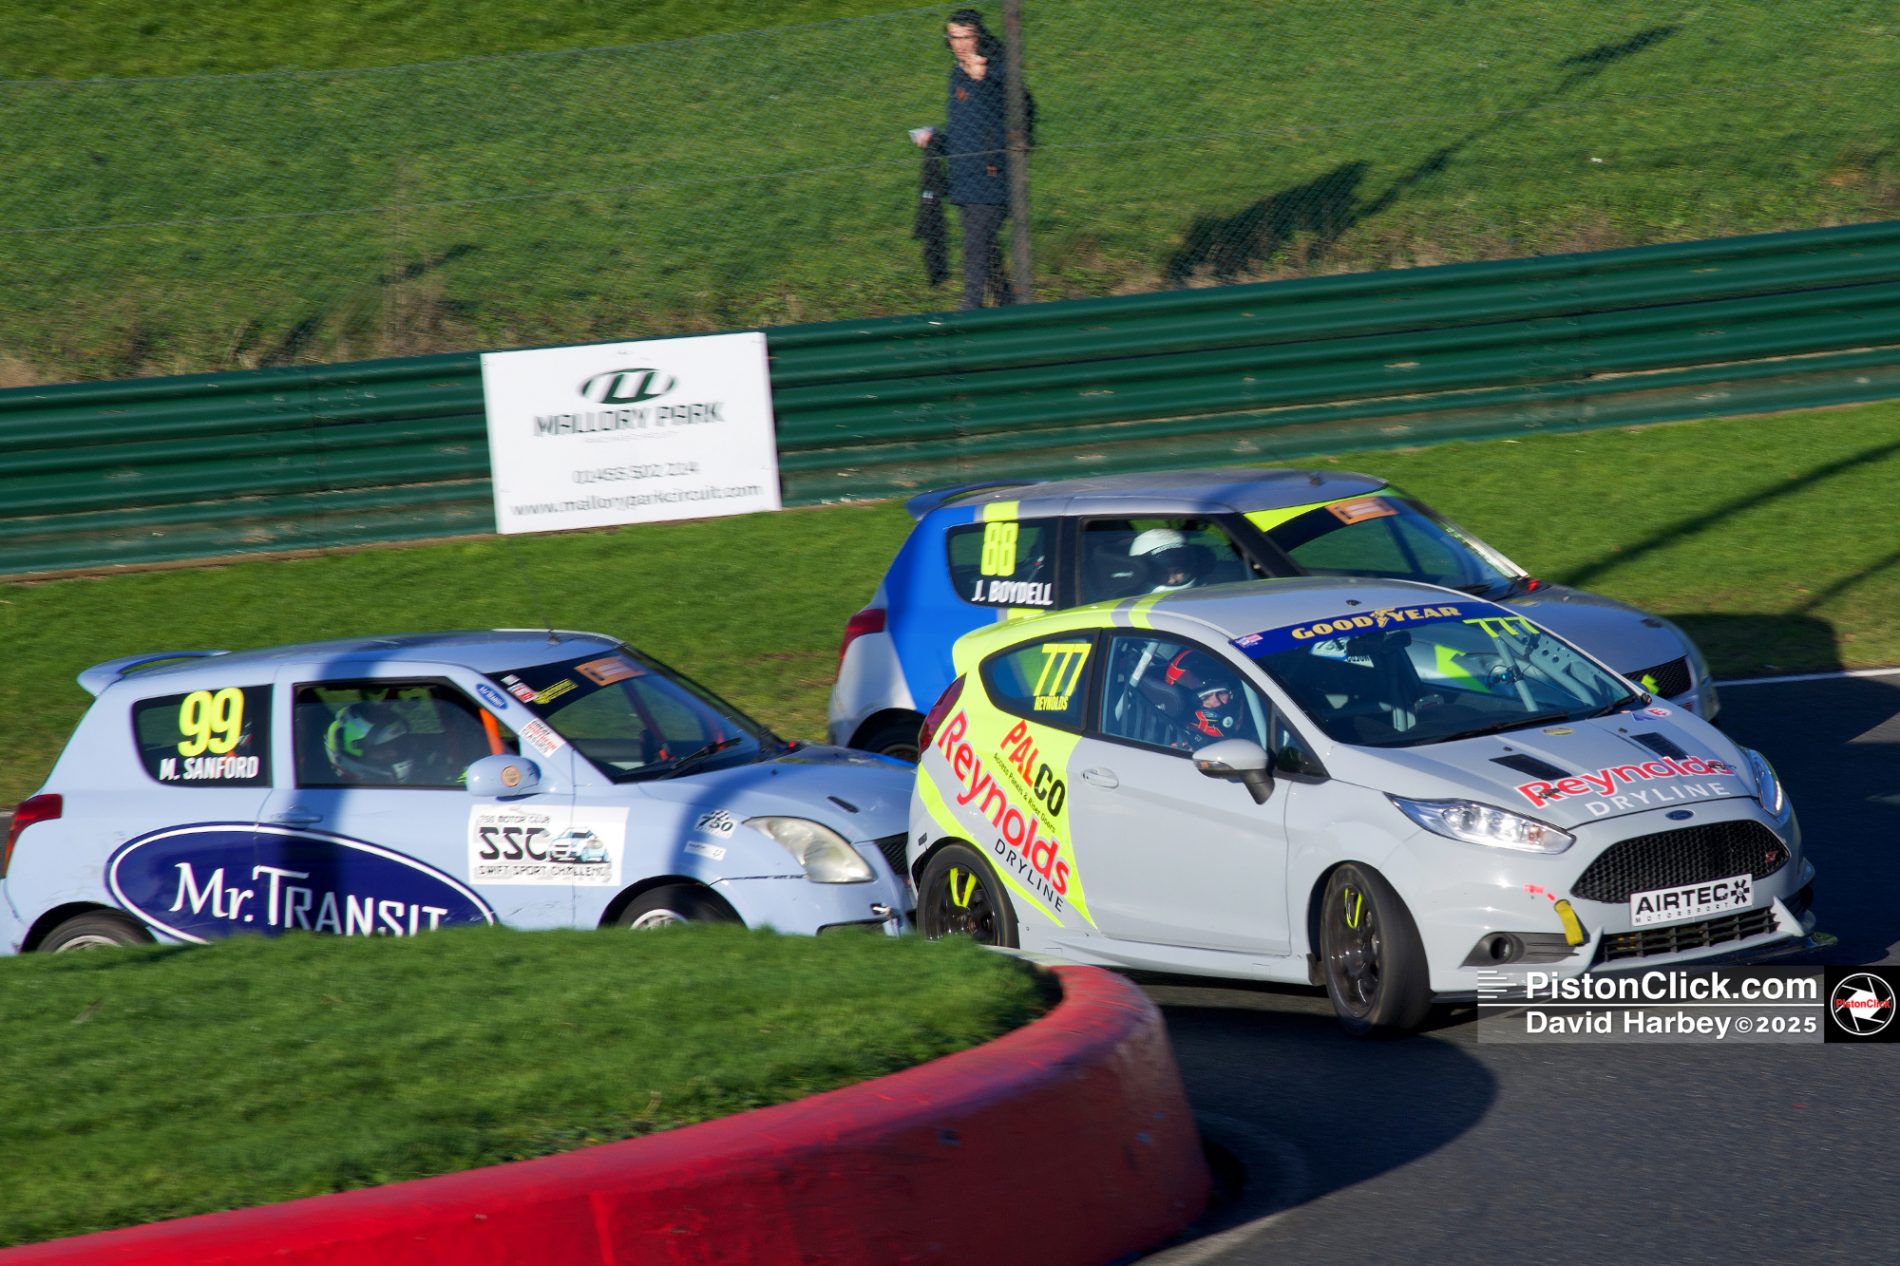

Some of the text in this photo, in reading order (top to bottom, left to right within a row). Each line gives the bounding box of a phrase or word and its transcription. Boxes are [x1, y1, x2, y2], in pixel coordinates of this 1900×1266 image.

[534, 409, 649, 436] MALLORY
[655, 402, 724, 426] PARK
[980, 521, 1018, 577] 88
[972, 581, 1053, 606] J. BOYDELL
[1463, 616, 1540, 638] 777
[1033, 643, 1092, 697] 777
[1034, 695, 1068, 711] REYNOLDS
[178, 687, 244, 757] 99
[160, 755, 259, 780] M. SANFORD
[1000, 719, 1066, 817] PALCO
[1516, 755, 1735, 809] Reynolds
[937, 710, 1070, 895] Reynolds
[1584, 782, 1731, 817] DRYLINE
[479, 826, 548, 860] SSC
[479, 865, 509, 875] SWIFT
[513, 865, 547, 876] SPORT
[994, 838, 1063, 913] DRYLINE
[1636, 883, 1729, 915] AIRTEC
